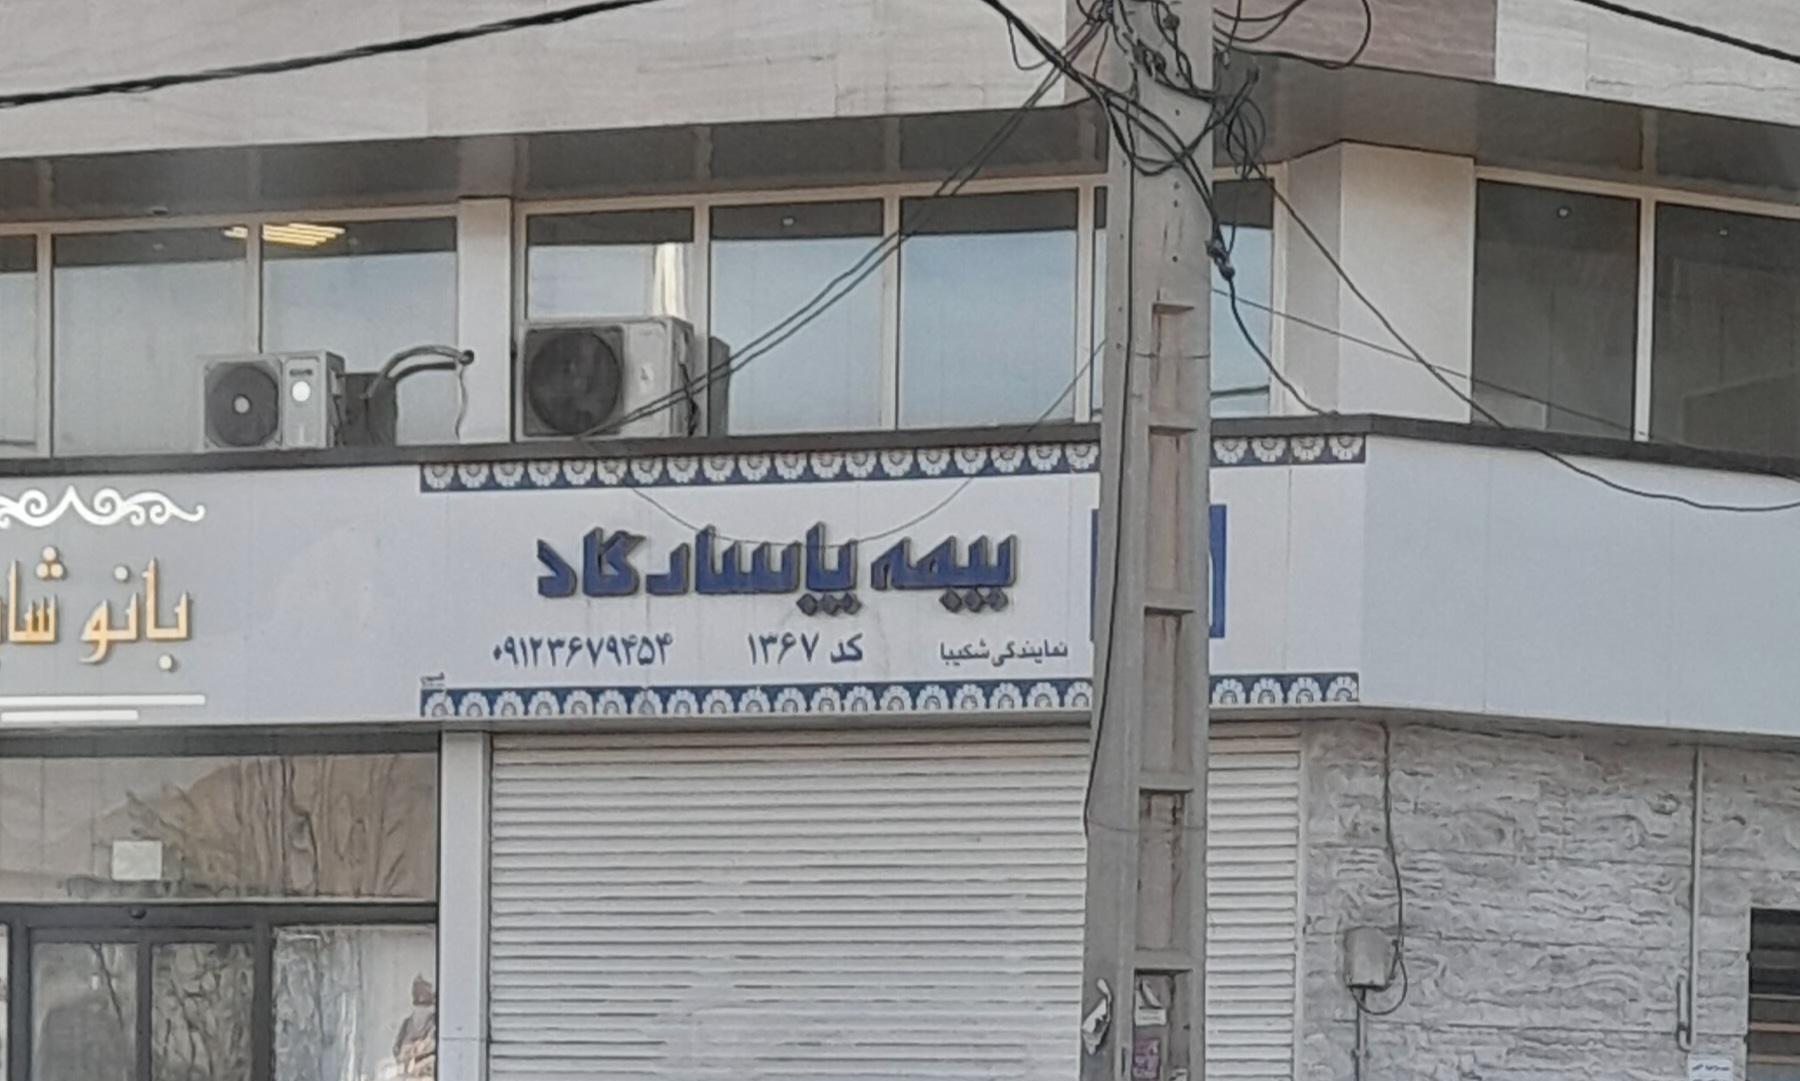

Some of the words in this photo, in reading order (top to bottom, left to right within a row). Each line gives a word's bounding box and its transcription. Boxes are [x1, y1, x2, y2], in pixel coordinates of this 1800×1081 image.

[536, 521, 863, 616] پاسارگاد
[870, 534, 1018, 613] بیمه
[79, 556, 191, 671] بانو
[747, 631, 820, 665] ۱۳۶۷
[829, 632, 864, 665] کد
[939, 637, 991, 667] شکیبا
[990, 638, 1069, 668] نمایندگی
